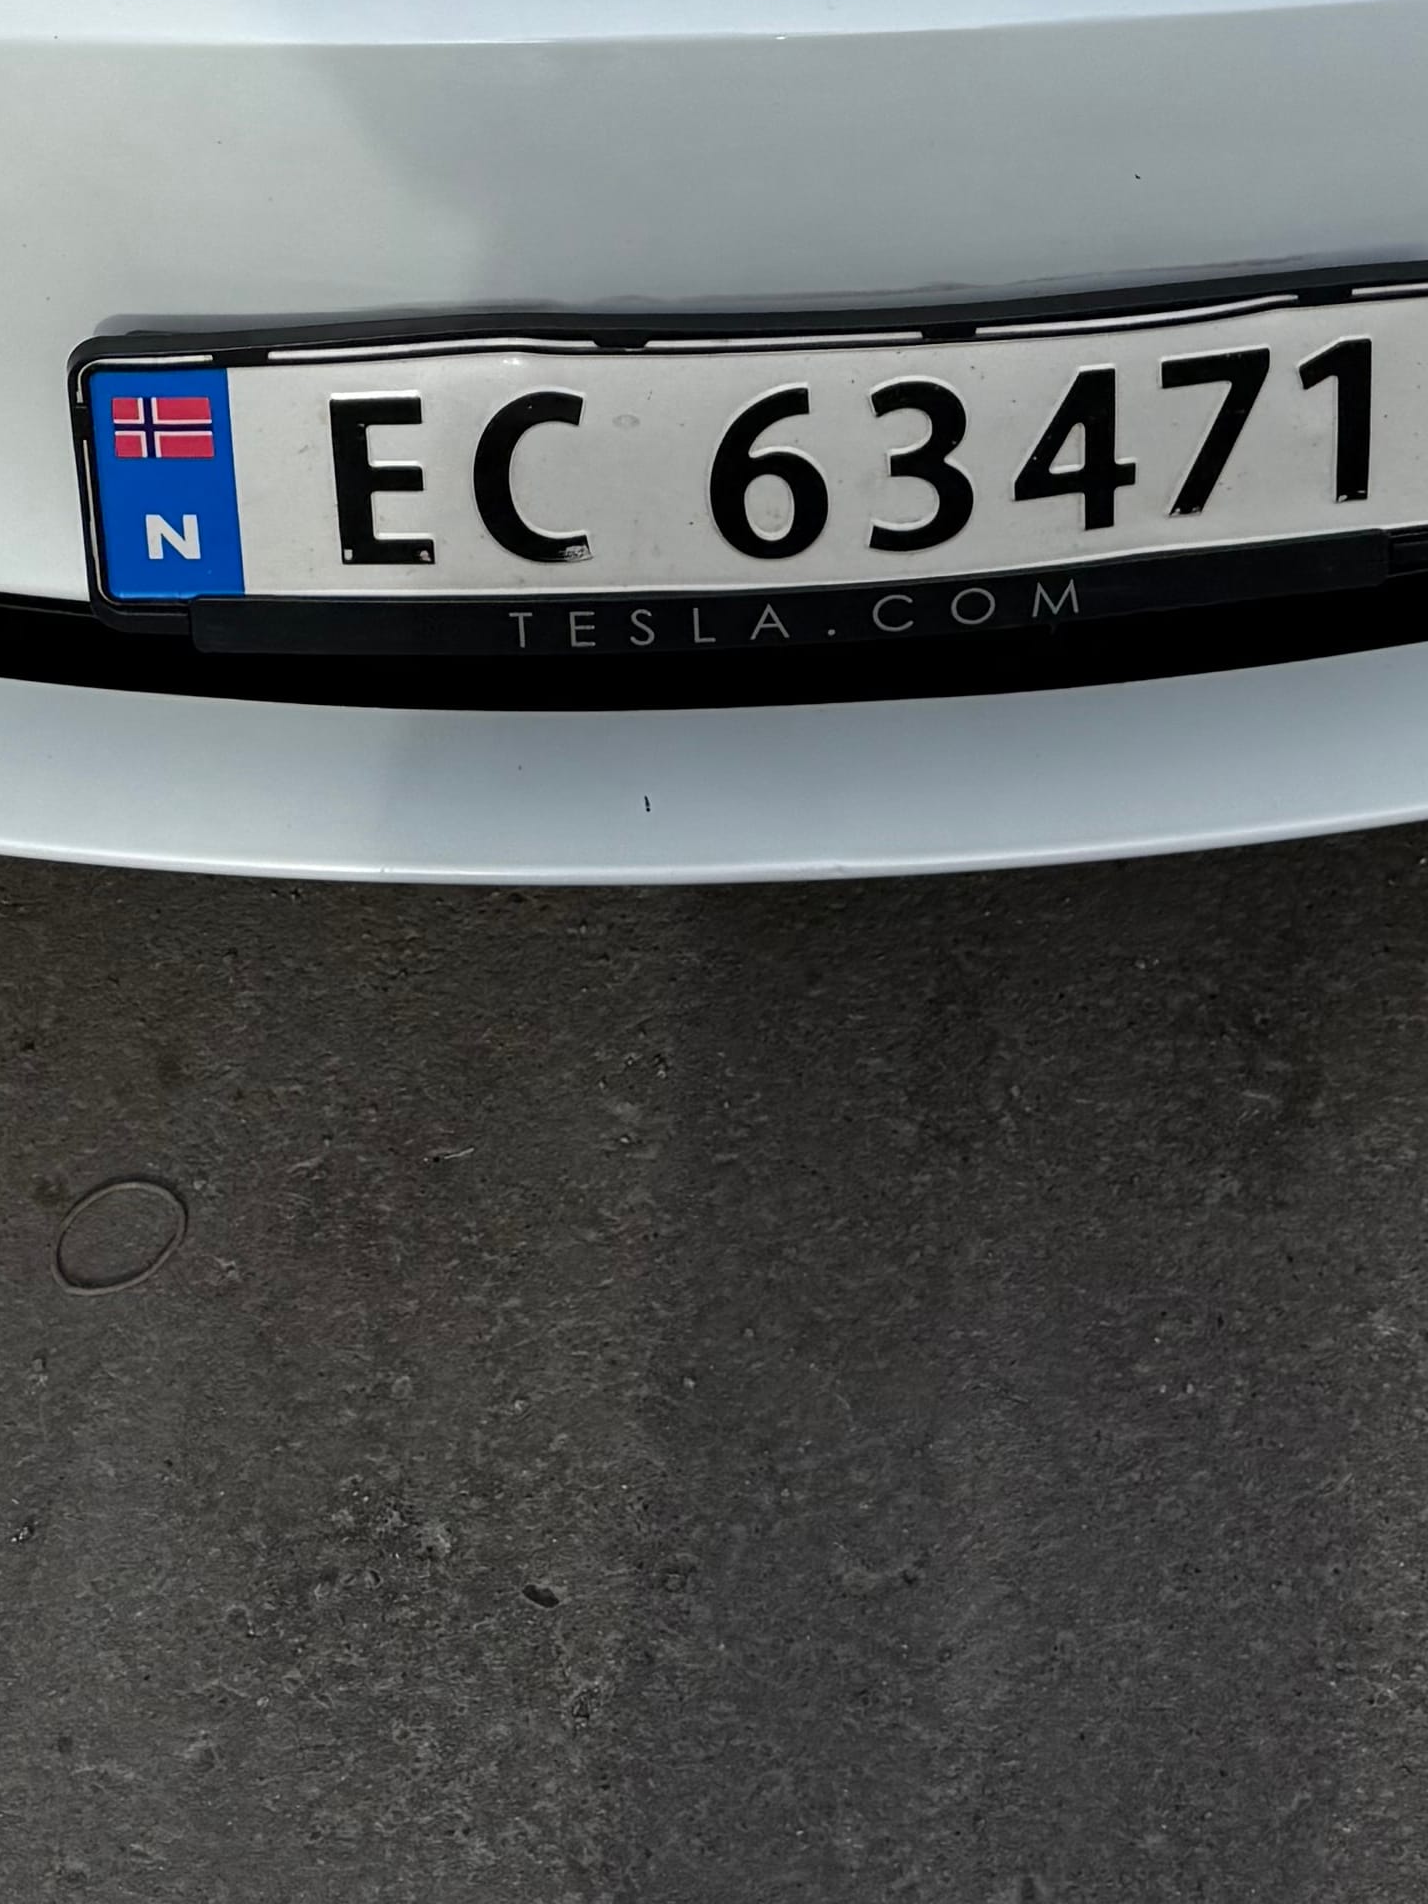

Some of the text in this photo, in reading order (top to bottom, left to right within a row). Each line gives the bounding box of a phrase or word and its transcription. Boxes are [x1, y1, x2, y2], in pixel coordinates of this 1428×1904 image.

[329, 337, 1373, 566] EC 63471
[145, 513, 202, 561] N
[509, 578, 1081, 648] TESLA.COM
